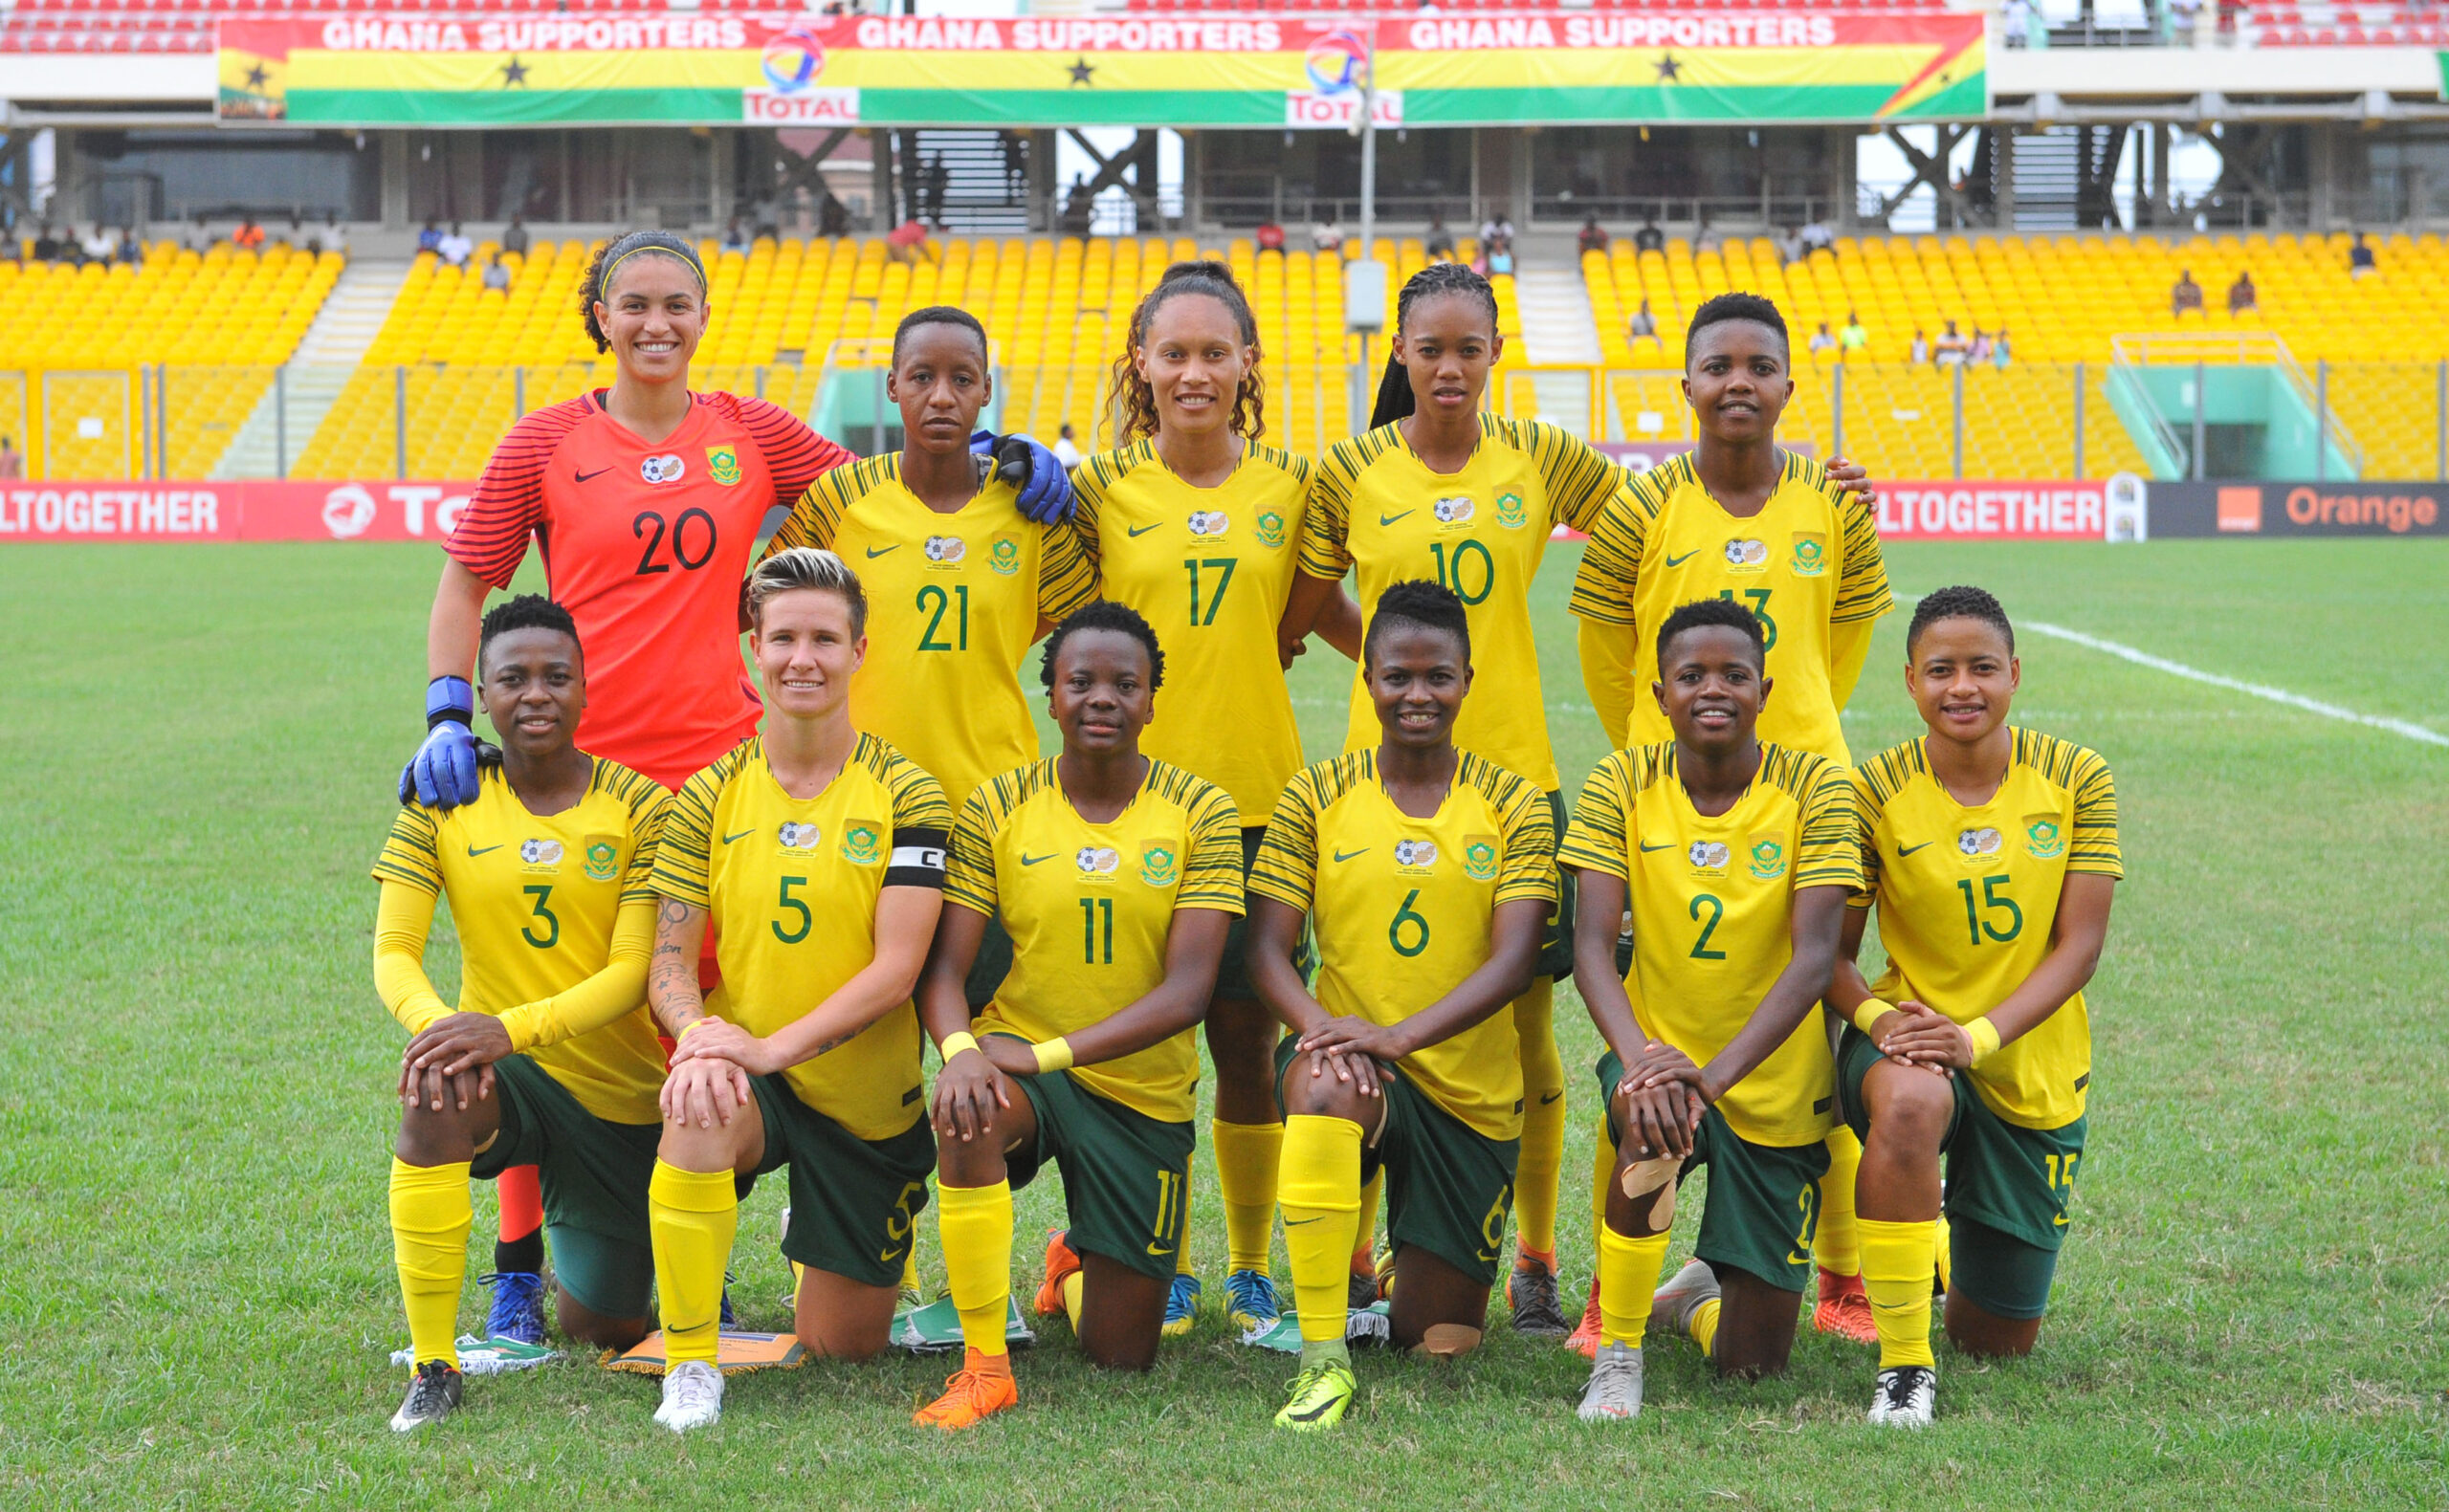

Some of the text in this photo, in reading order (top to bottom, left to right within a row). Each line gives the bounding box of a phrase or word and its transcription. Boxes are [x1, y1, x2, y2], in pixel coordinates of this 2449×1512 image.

[322, 21, 468, 49] GHANA
[478, 19, 746, 50] SUPPORTERS
[857, 19, 1002, 49] GHANA
[1012, 20, 1281, 50] SUPPORTERS
[1410, 17, 1835, 49] GHANA SUPPORTERS
[745, 94, 858, 120] TOTAL
[1287, 95, 1403, 121] TOTL
[632, 507, 717, 575] 20
[1878, 491, 2102, 533] LTOGETHER
[2285, 486, 2438, 533] Orange
[1183, 558, 1238, 626] 17
[1429, 538, 1494, 605] 10
[916, 584, 968, 651] 21
[1720, 588, 1777, 653] 3
[521, 885, 559, 949] 3
[771, 875, 812, 944] 5
[1079, 898, 1113, 964] 11
[1389, 888, 1429, 957] 6
[1689, 893, 1726, 960] 2
[1957, 874, 2023, 945] 15
[887, 1181, 922, 1241] 5
[1154, 1170, 1181, 1240] 11
[1482, 1184, 1508, 1249] 6
[1797, 1182, 1814, 1250] 2
